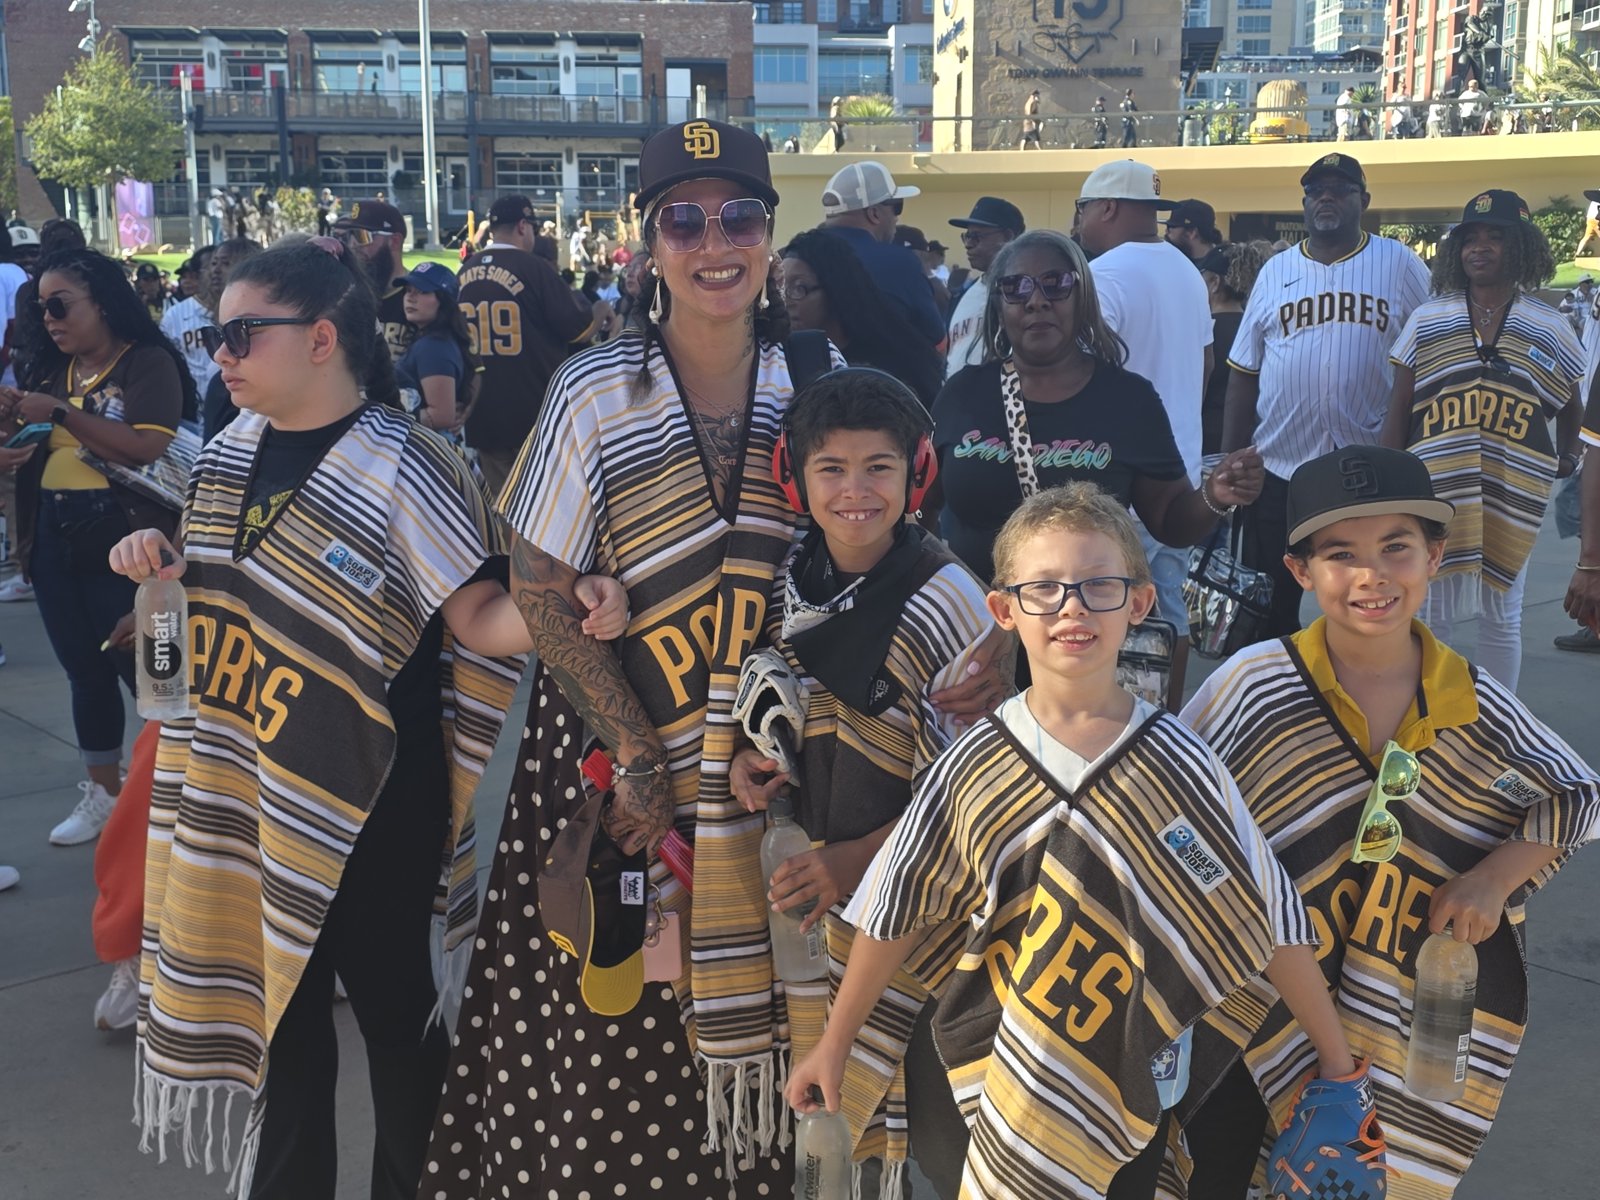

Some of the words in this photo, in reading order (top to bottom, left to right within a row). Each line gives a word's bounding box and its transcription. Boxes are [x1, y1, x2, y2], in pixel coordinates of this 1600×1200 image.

[1008, 68, 1039, 79] TONY
[1042, 68, 1089, 79] GWYNN
[1093, 66, 1144, 78] TERRACE
[683, 121, 721, 160] SD
[1279, 291, 1390, 338] PADRES
[1422, 388, 1535, 441] PADRES
[954, 429, 1015, 464] SAN
[1031, 439, 1113, 471] DIEGO
[346, 556, 378, 580] SOAPY
[150, 610, 171, 672] smart
[169, 610, 179, 639] water
[1513, 781, 1541, 799] SOAPY
[1184, 852, 1213, 882] JOE'S
[1188, 842, 1222, 877] SOAPY
